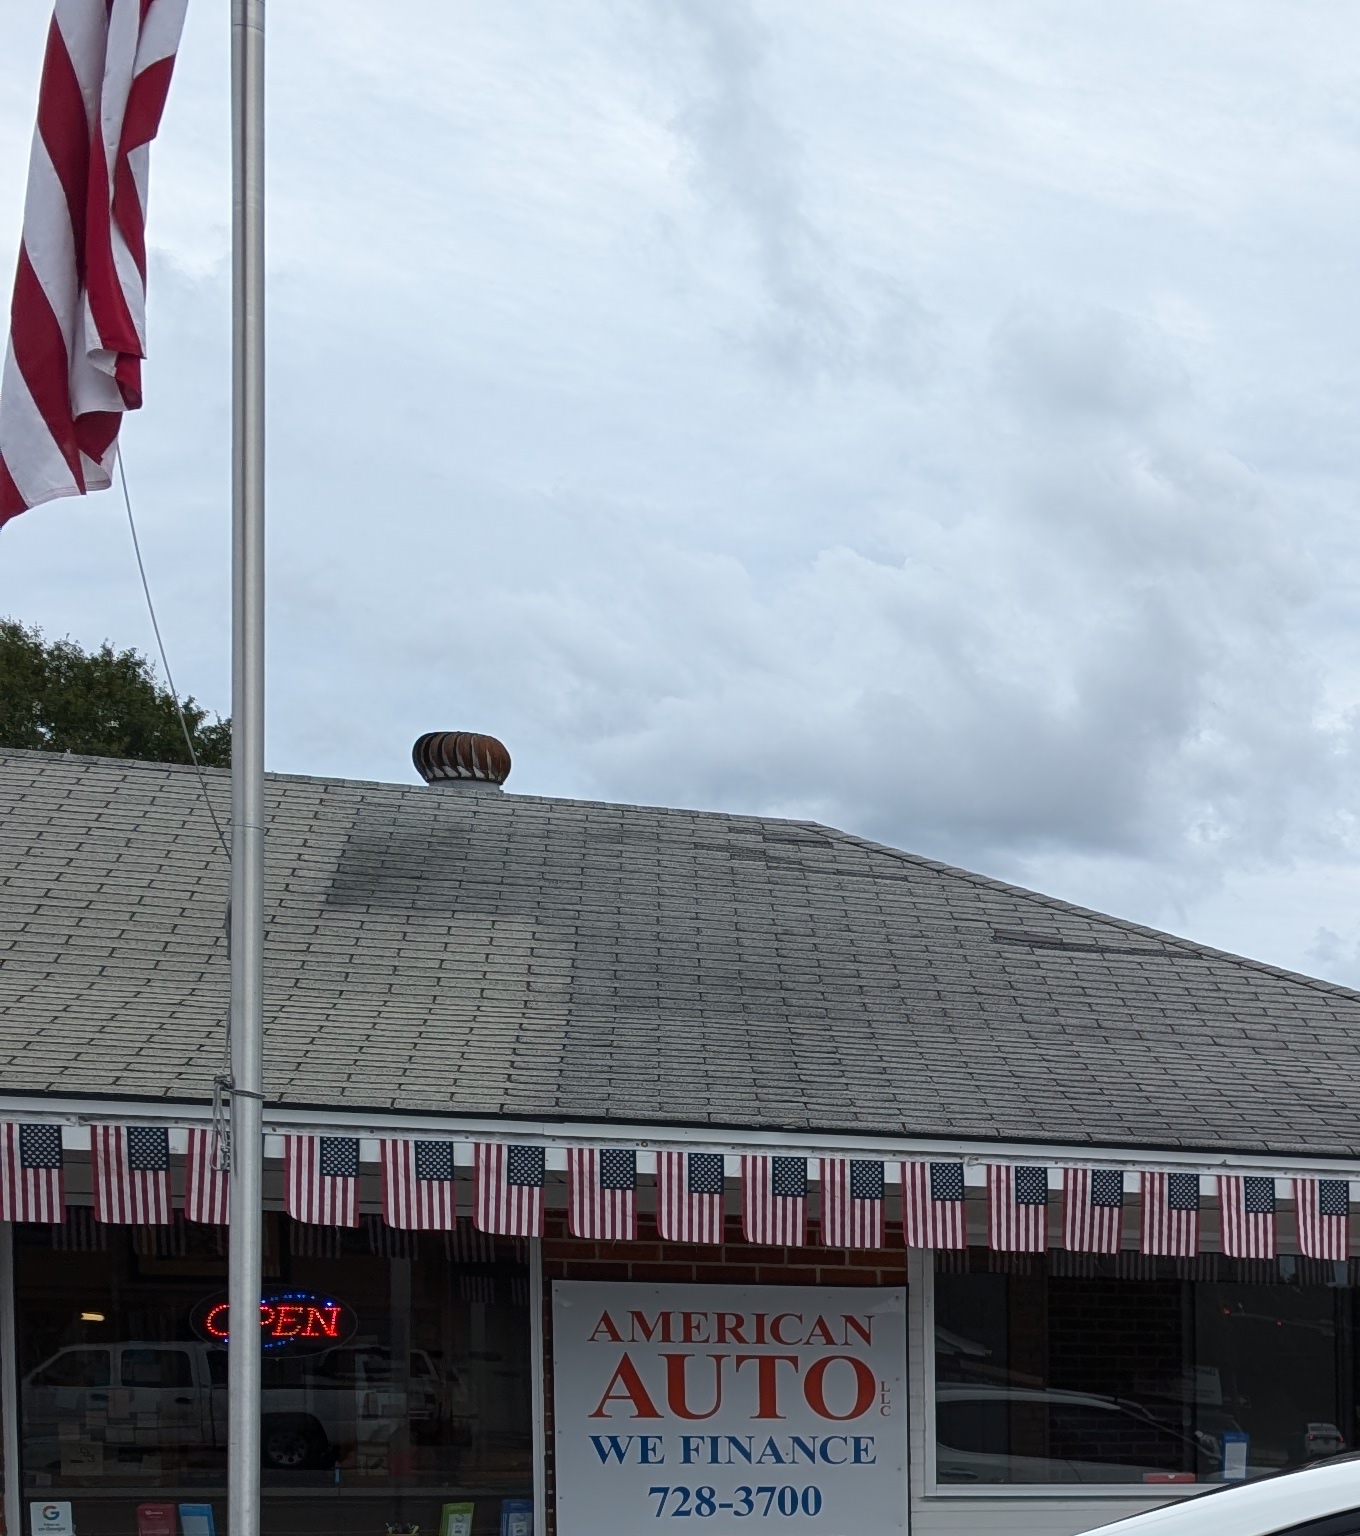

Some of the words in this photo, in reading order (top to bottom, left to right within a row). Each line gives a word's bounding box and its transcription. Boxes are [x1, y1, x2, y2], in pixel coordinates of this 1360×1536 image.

[587, 1310, 874, 1346] AMERICAN
[587, 1352, 877, 1421] AUTO
[880, 1381, 891, 1417] LLC
[588, 1435, 665, 1465] WE
[678, 1435, 877, 1465] FINANCE
[648, 1485, 823, 1518] 728-3700
